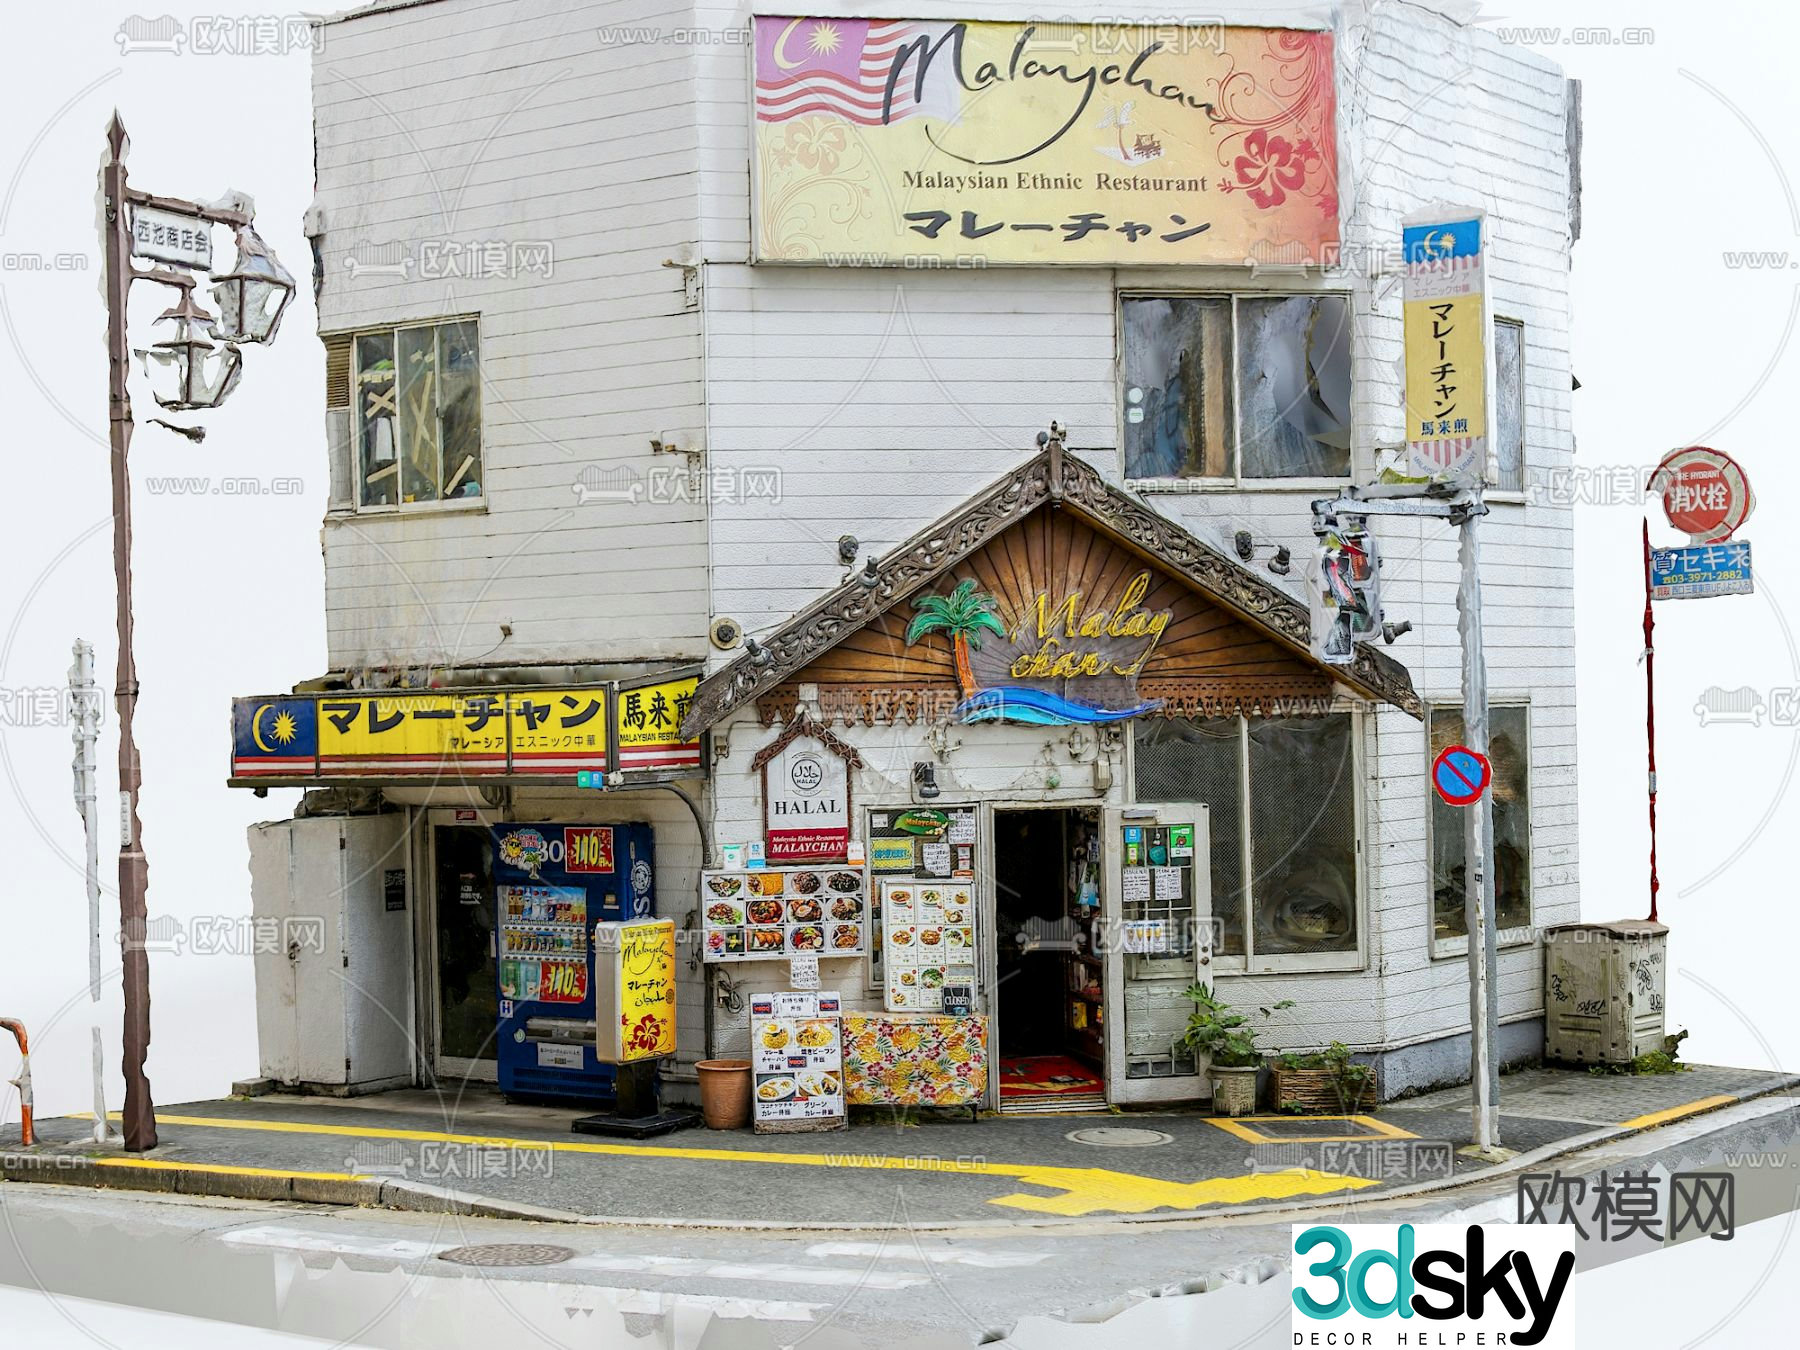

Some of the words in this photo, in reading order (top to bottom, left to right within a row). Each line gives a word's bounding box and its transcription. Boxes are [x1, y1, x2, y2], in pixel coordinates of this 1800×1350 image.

[882, 23, 1225, 165] Malaychan
[902, 170, 1009, 193] Malaysian
[1016, 171, 1083, 192] Ethnic
[1096, 172, 1209, 193] Restaurant
[903, 210, 1212, 243] マレーチャン
[1427, 302, 1458, 420] マレーチャン
[1690, 469, 1721, 481] HYDRANT
[1668, 481, 1729, 514] 消火栓
[1677, 545, 1751, 574] セキネ
[1671, 569, 1743, 584] 03-3971-2882
[1008, 571, 1170, 677] Malay
[321, 694, 602, 735] マレーチャン
[449, 735, 505, 750] マレーシア
[619, 733, 657, 743] MALAYSIAN
[794, 765, 820, 779] حلال
[774, 800, 842, 815] HALAL
[772, 842, 845, 854] MALAYCHAN
[627, 979, 668, 992] マレーチャン
[944, 996, 970, 1007] CLOSED
